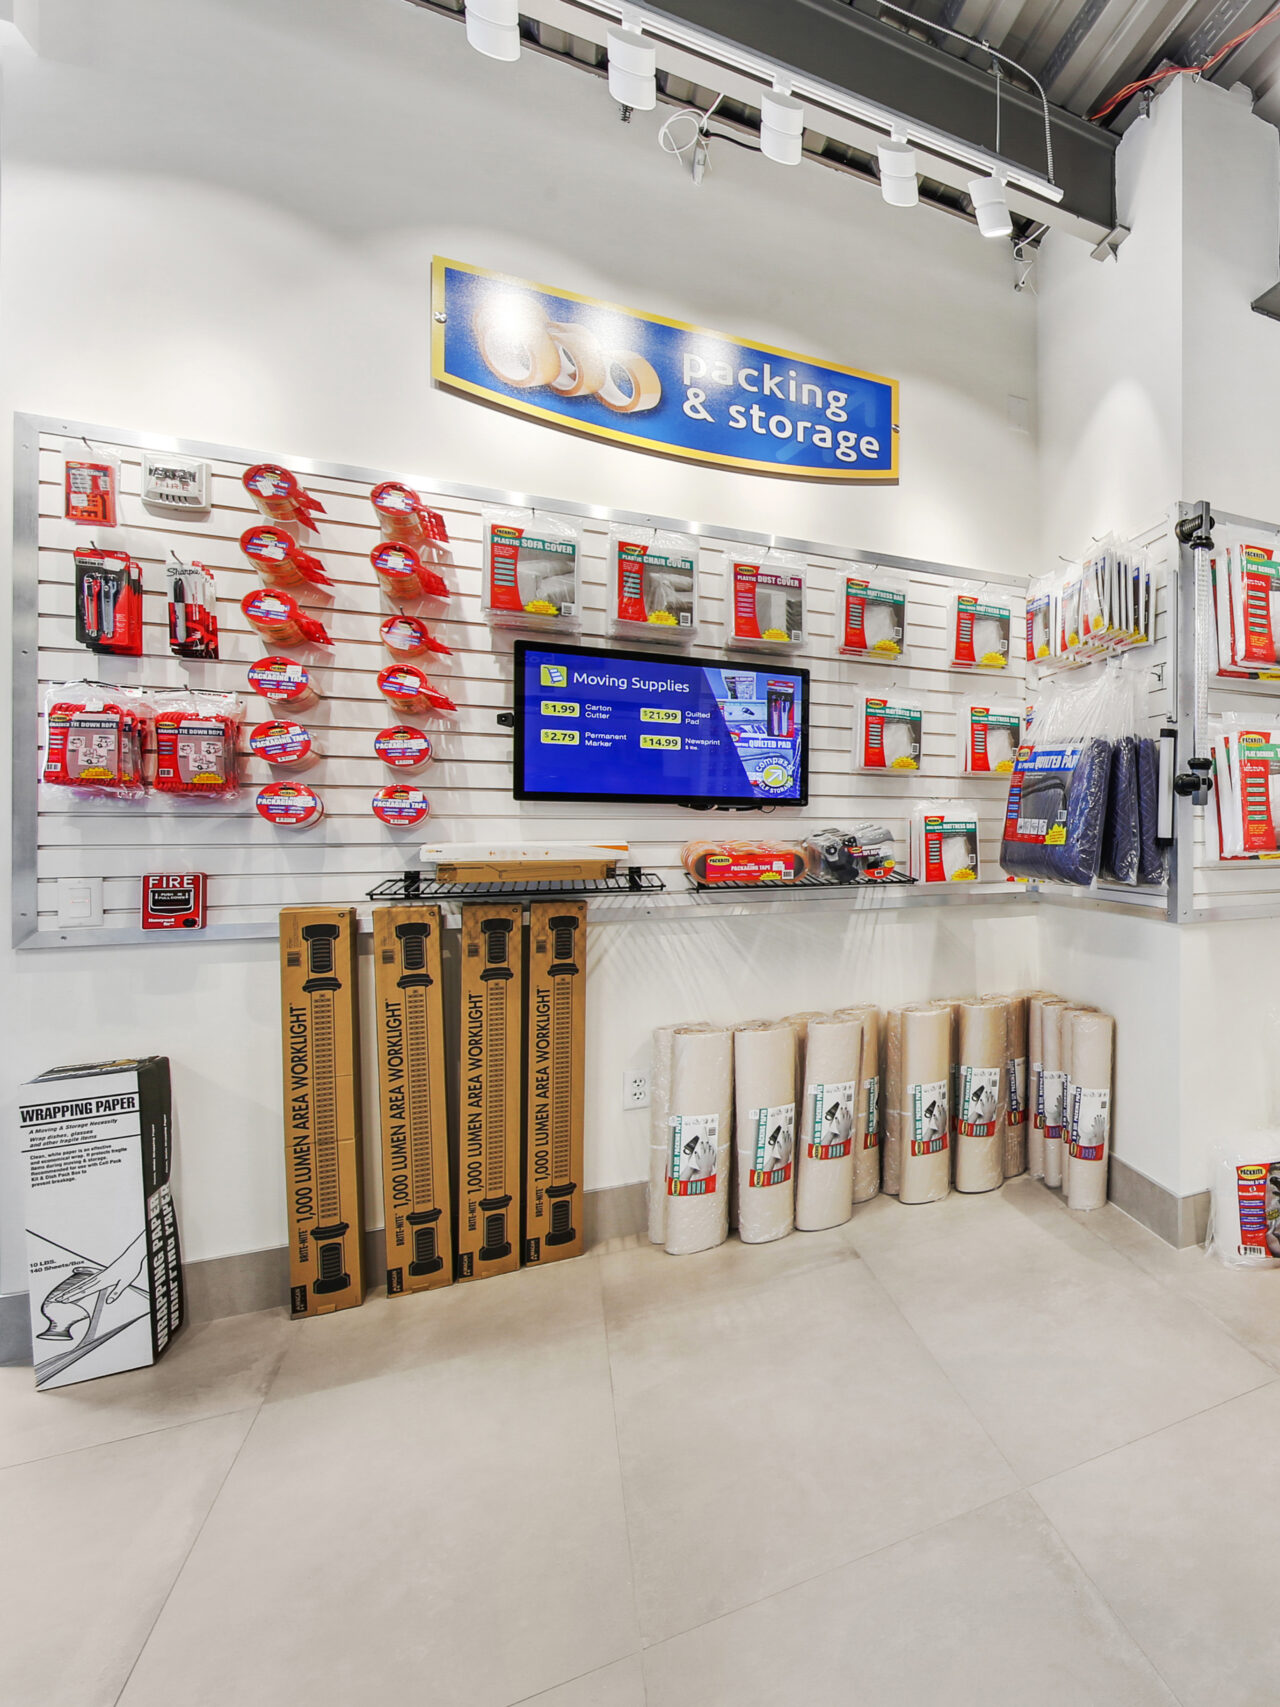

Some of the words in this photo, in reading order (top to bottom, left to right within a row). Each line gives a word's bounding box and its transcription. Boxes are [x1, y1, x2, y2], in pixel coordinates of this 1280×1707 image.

[682, 353, 848, 422] packing
[682, 386, 715, 423] &
[728, 402, 880, 463] storage
[494, 537, 520, 546] PLASTIC
[522, 539, 543, 549] SOFA
[545, 542, 572, 554] COVER
[167, 568, 200, 577] Sharpie
[644, 556, 665, 566] CHAIR
[667, 559, 690, 569] COVER
[758, 575, 775, 583] DUST
[777, 577, 799, 587] COVER
[249, 673, 289, 682] PACKAGING
[290, 674, 308, 683] TAPE
[574, 672, 627, 690] Moving
[632, 678, 689, 693] Supplies
[545, 704, 575, 713] $1.99
[644, 710, 677, 720] $21.99
[291, 734, 309, 743] TAPE
[545, 732, 575, 741] $2.79
[585, 732, 626, 740] Permanent
[643, 737, 678, 747] $14.99
[685, 738, 720, 746] Newsprint
[749, 740, 776, 748] QUILTED
[149, 876, 194, 888] FIRE
[385, 1002, 404, 1082] WORKLIGHT
[468, 994, 484, 1071] WORKLIGHT
[535, 989, 551, 1064] WORKLIGHT
[289, 1007, 309, 1090] WORKLIGHT
[468, 1074, 483, 1109] AREA
[535, 1066, 550, 1099] AREA
[20, 1102, 92, 1123] WRAPPING
[96, 1096, 135, 1113] PAPER
[291, 1094, 310, 1131] AREA
[388, 1085, 406, 1120] AREA
[467, 1113, 484, 1157] LUMEN
[534, 1103, 550, 1146] LUMEN
[293, 1137, 312, 1183] LUMEN
[390, 1124, 408, 1170] LUMEN
[467, 1161, 484, 1194] 1,000
[534, 1150, 551, 1182] 1,000
[295, 1187, 316, 1223] 1,000
[392, 1175, 412, 1208] 1,000
[148, 1193, 164, 1249] PAPER
[39, 1259, 57, 1268] LBS.
[152, 1253, 169, 1351] WRAPPING
